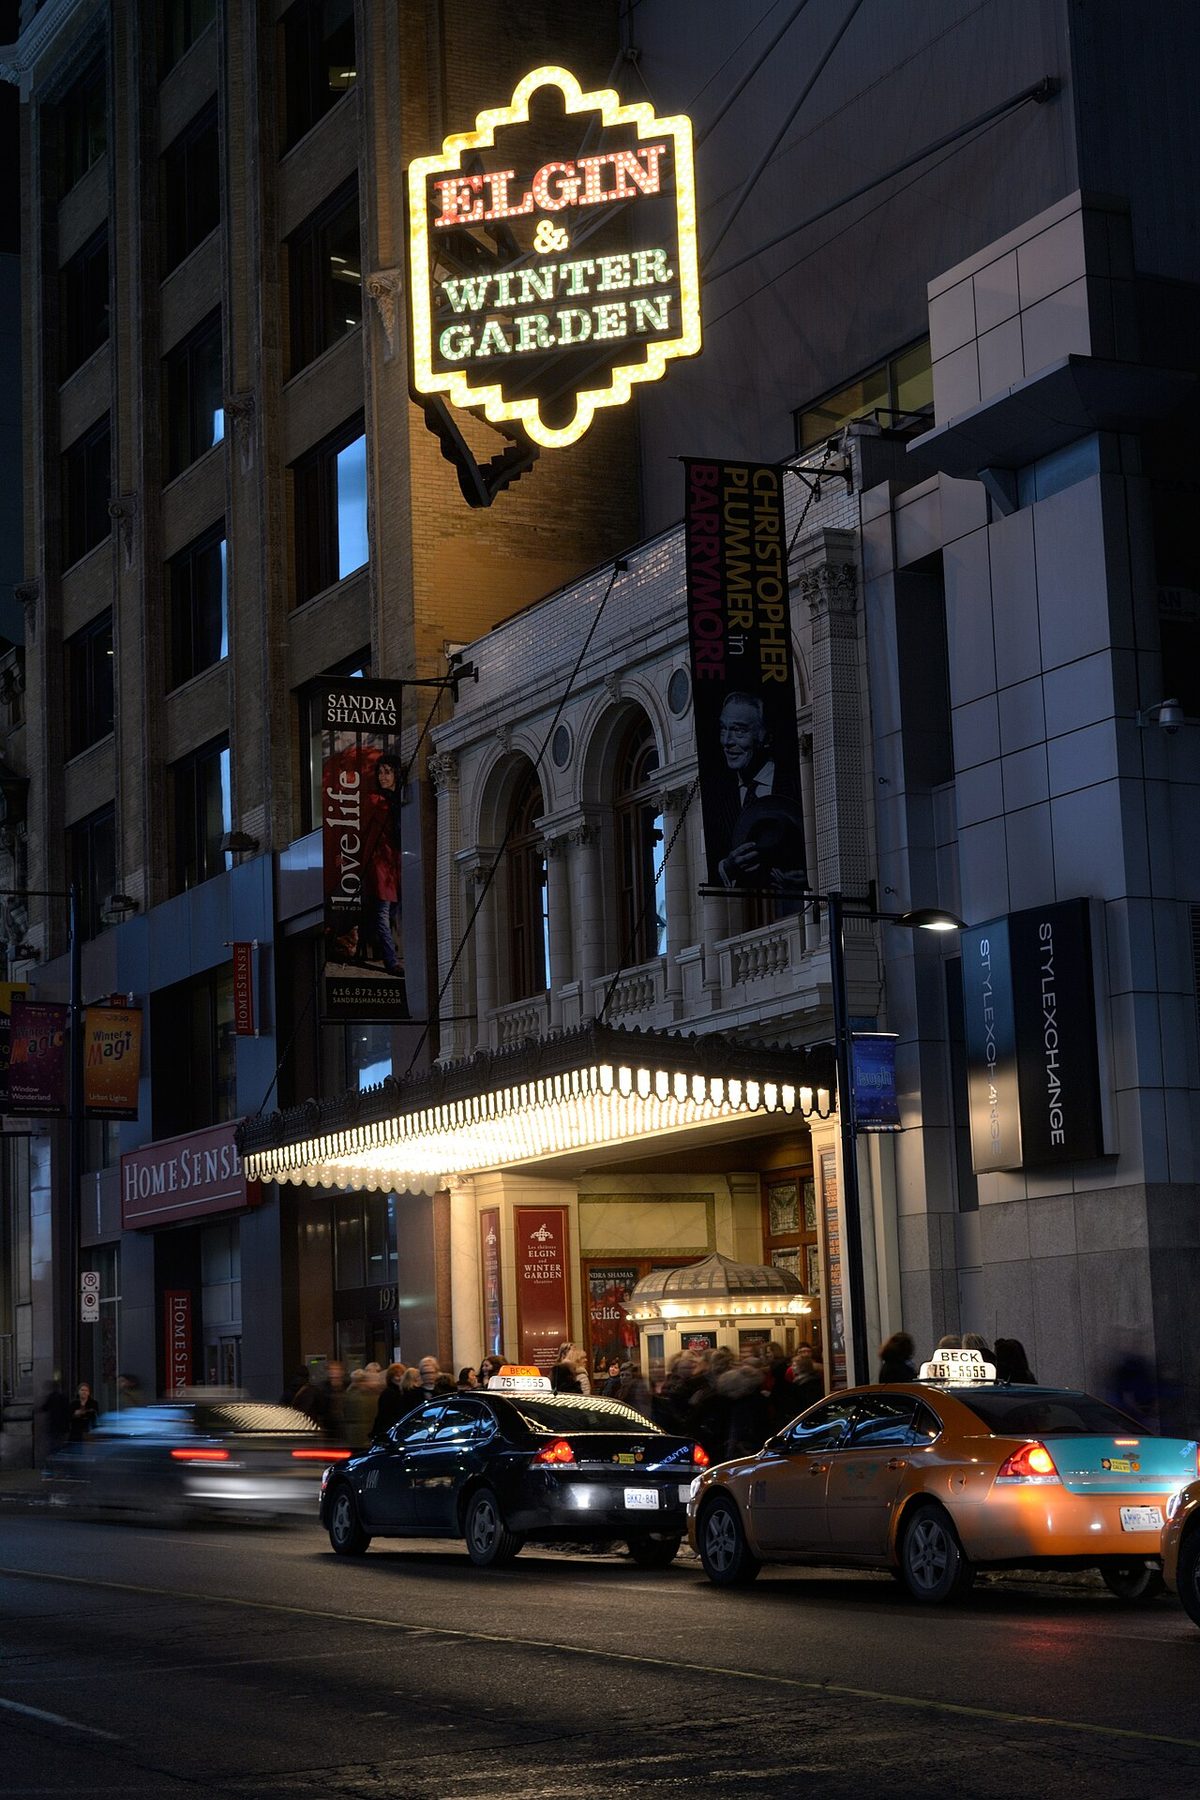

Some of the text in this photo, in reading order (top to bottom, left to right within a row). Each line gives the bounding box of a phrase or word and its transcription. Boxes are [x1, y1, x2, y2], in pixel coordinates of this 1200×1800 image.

[434, 144, 667, 226] ELGIN
[533, 219, 568, 254] &
[441, 248, 674, 312] WINTER
[439, 295, 672, 360] GARDEN
[723, 467, 754, 655] PLUMMER in
[690, 465, 725, 680] BARRYMORE
[752, 469, 788, 683] CHRISTOPHER
[328, 694, 397, 712] SANDRA
[327, 708, 397, 726] SHAMAS
[332, 987, 401, 997] 416.872.5555
[93, 1031, 122, 1041] Winter
[1039, 923, 1065, 1146] STYLEXCHANGE
[528, 1250, 556, 1258] ELGIN
[524, 1264, 562, 1272] WINTER
[524, 1271, 562, 1279] GARDEN
[590, 1306, 620, 1320] velife
[174, 1297, 188, 1398] HOMESENS
[941, 1352, 980, 1362] BECK
[510, 1367, 532, 1375] BECK
